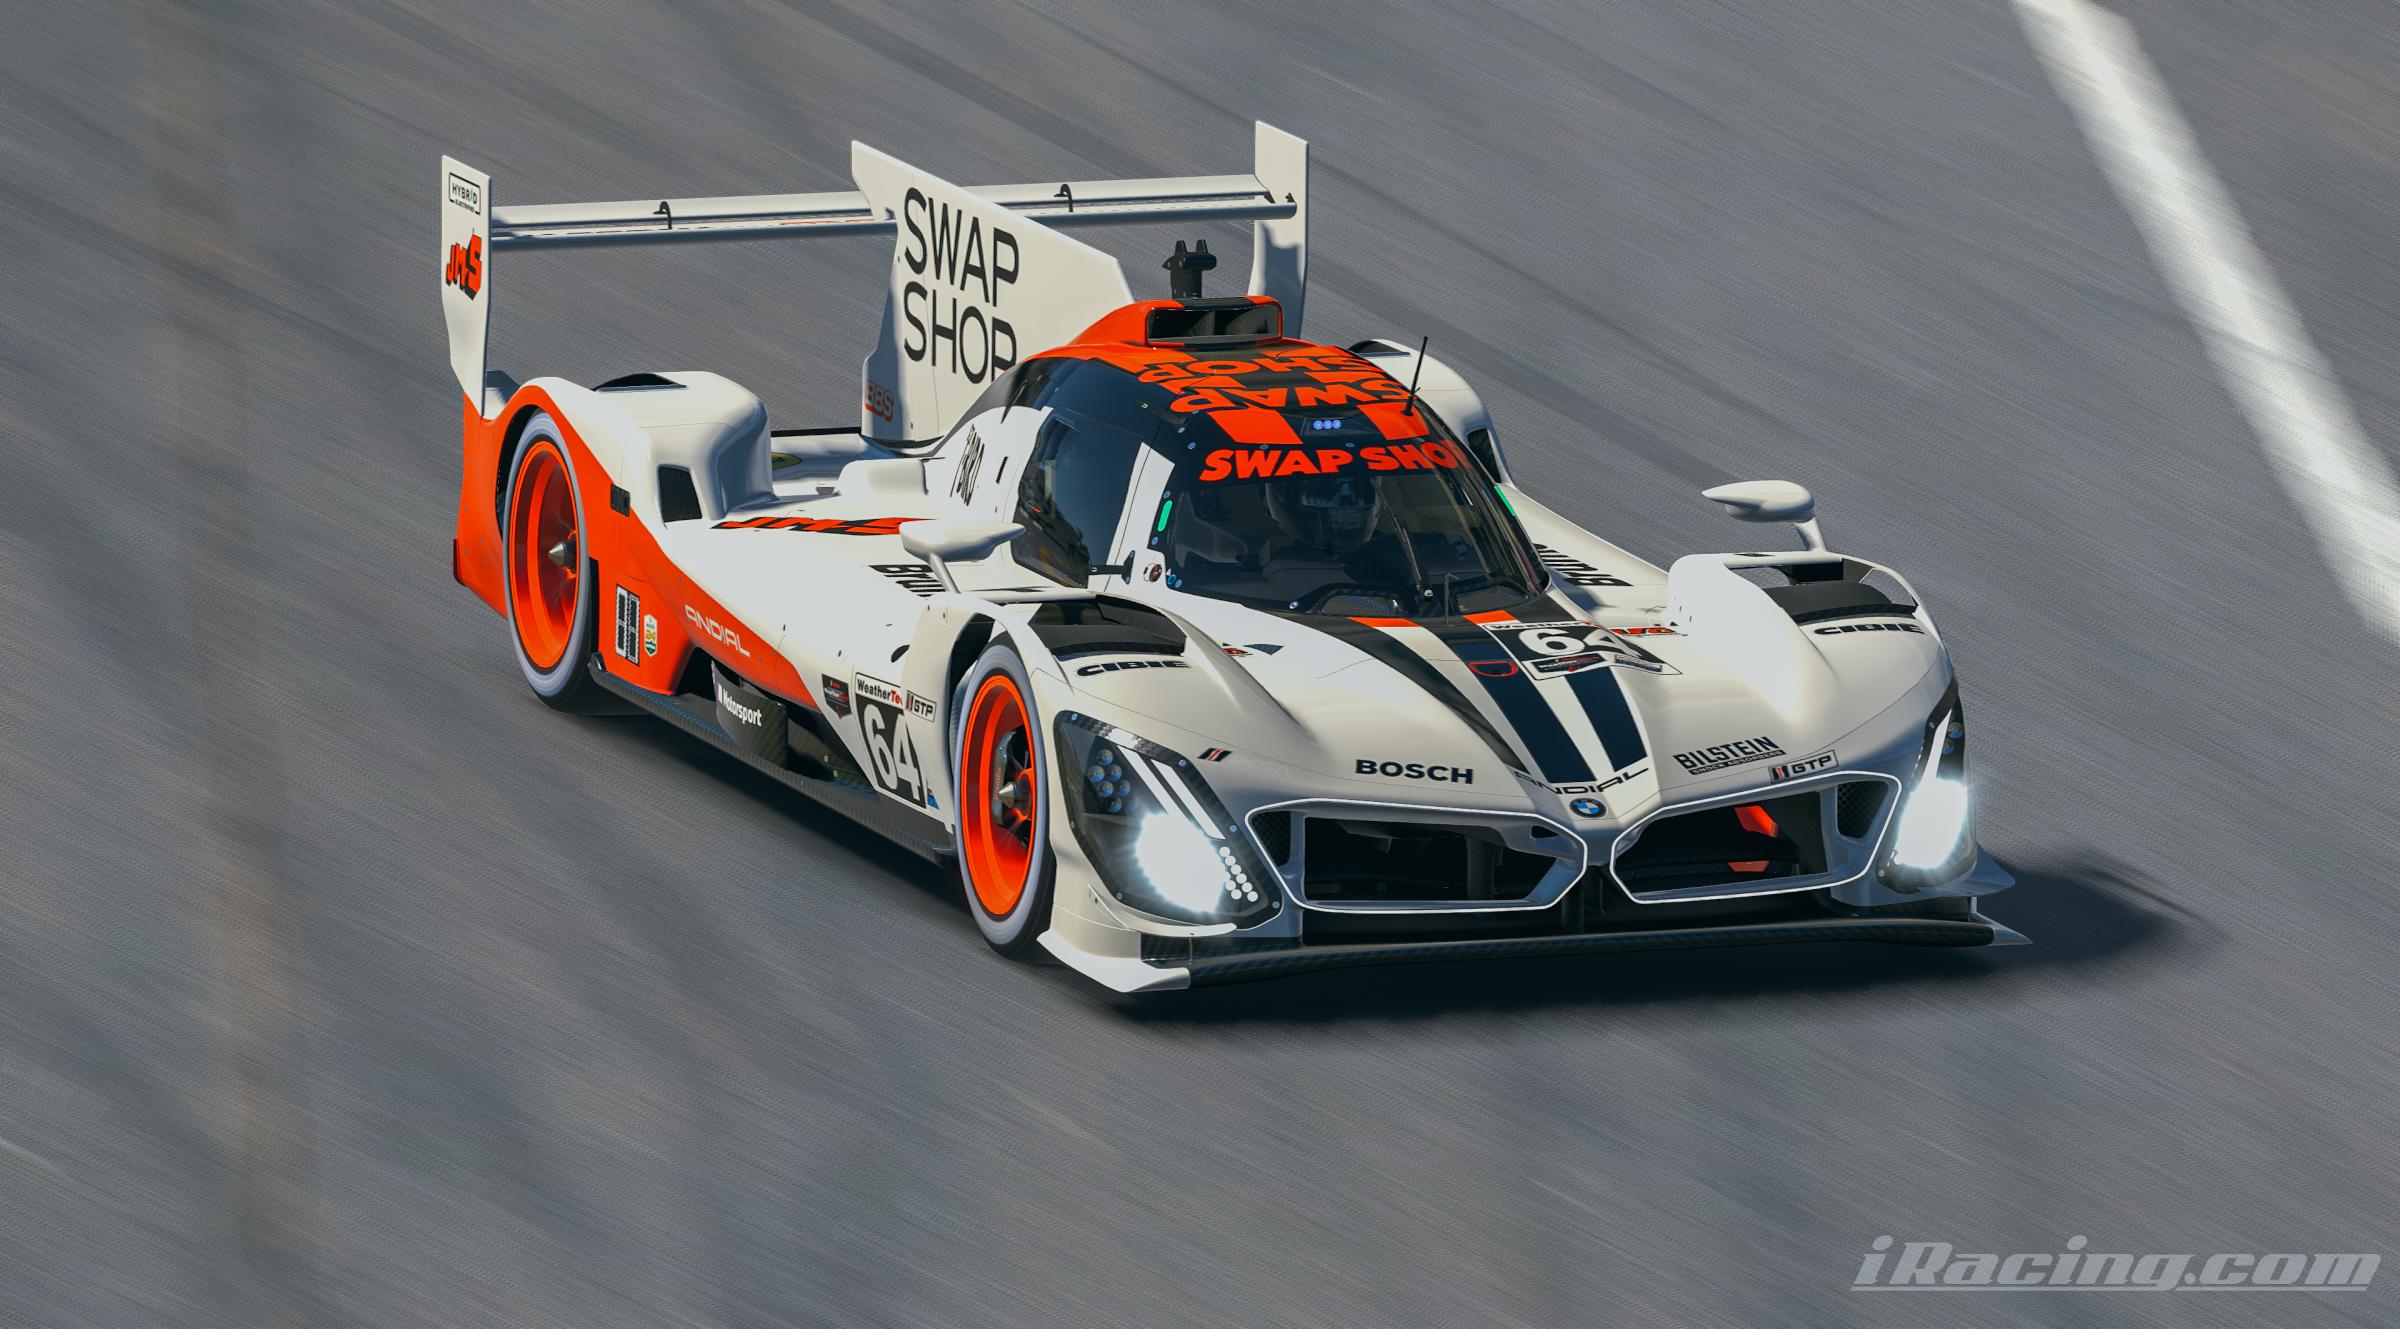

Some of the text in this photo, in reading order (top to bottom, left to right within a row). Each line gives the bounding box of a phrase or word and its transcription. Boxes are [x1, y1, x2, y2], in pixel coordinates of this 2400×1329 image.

[904, 187, 1019, 307] SWAP
[446, 232, 482, 300] JMS
[904, 281, 1017, 385] SHOP
[1170, 379, 1416, 413] SWAP
[1199, 449, 1354, 482] SWAP
[684, 604, 751, 658] ANDIAL
[1518, 628, 1643, 659] 64
[1076, 660, 1192, 677] CIBIE
[722, 688, 763, 728] Motorsport
[913, 700, 934, 718] GTP
[863, 703, 922, 802] 64
[1672, 736, 1780, 770] BILSTEIN
[1792, 755, 1832, 775] GTP
[1355, 759, 1474, 785] BOSCH
[1513, 768, 1650, 795] ANDIAL
